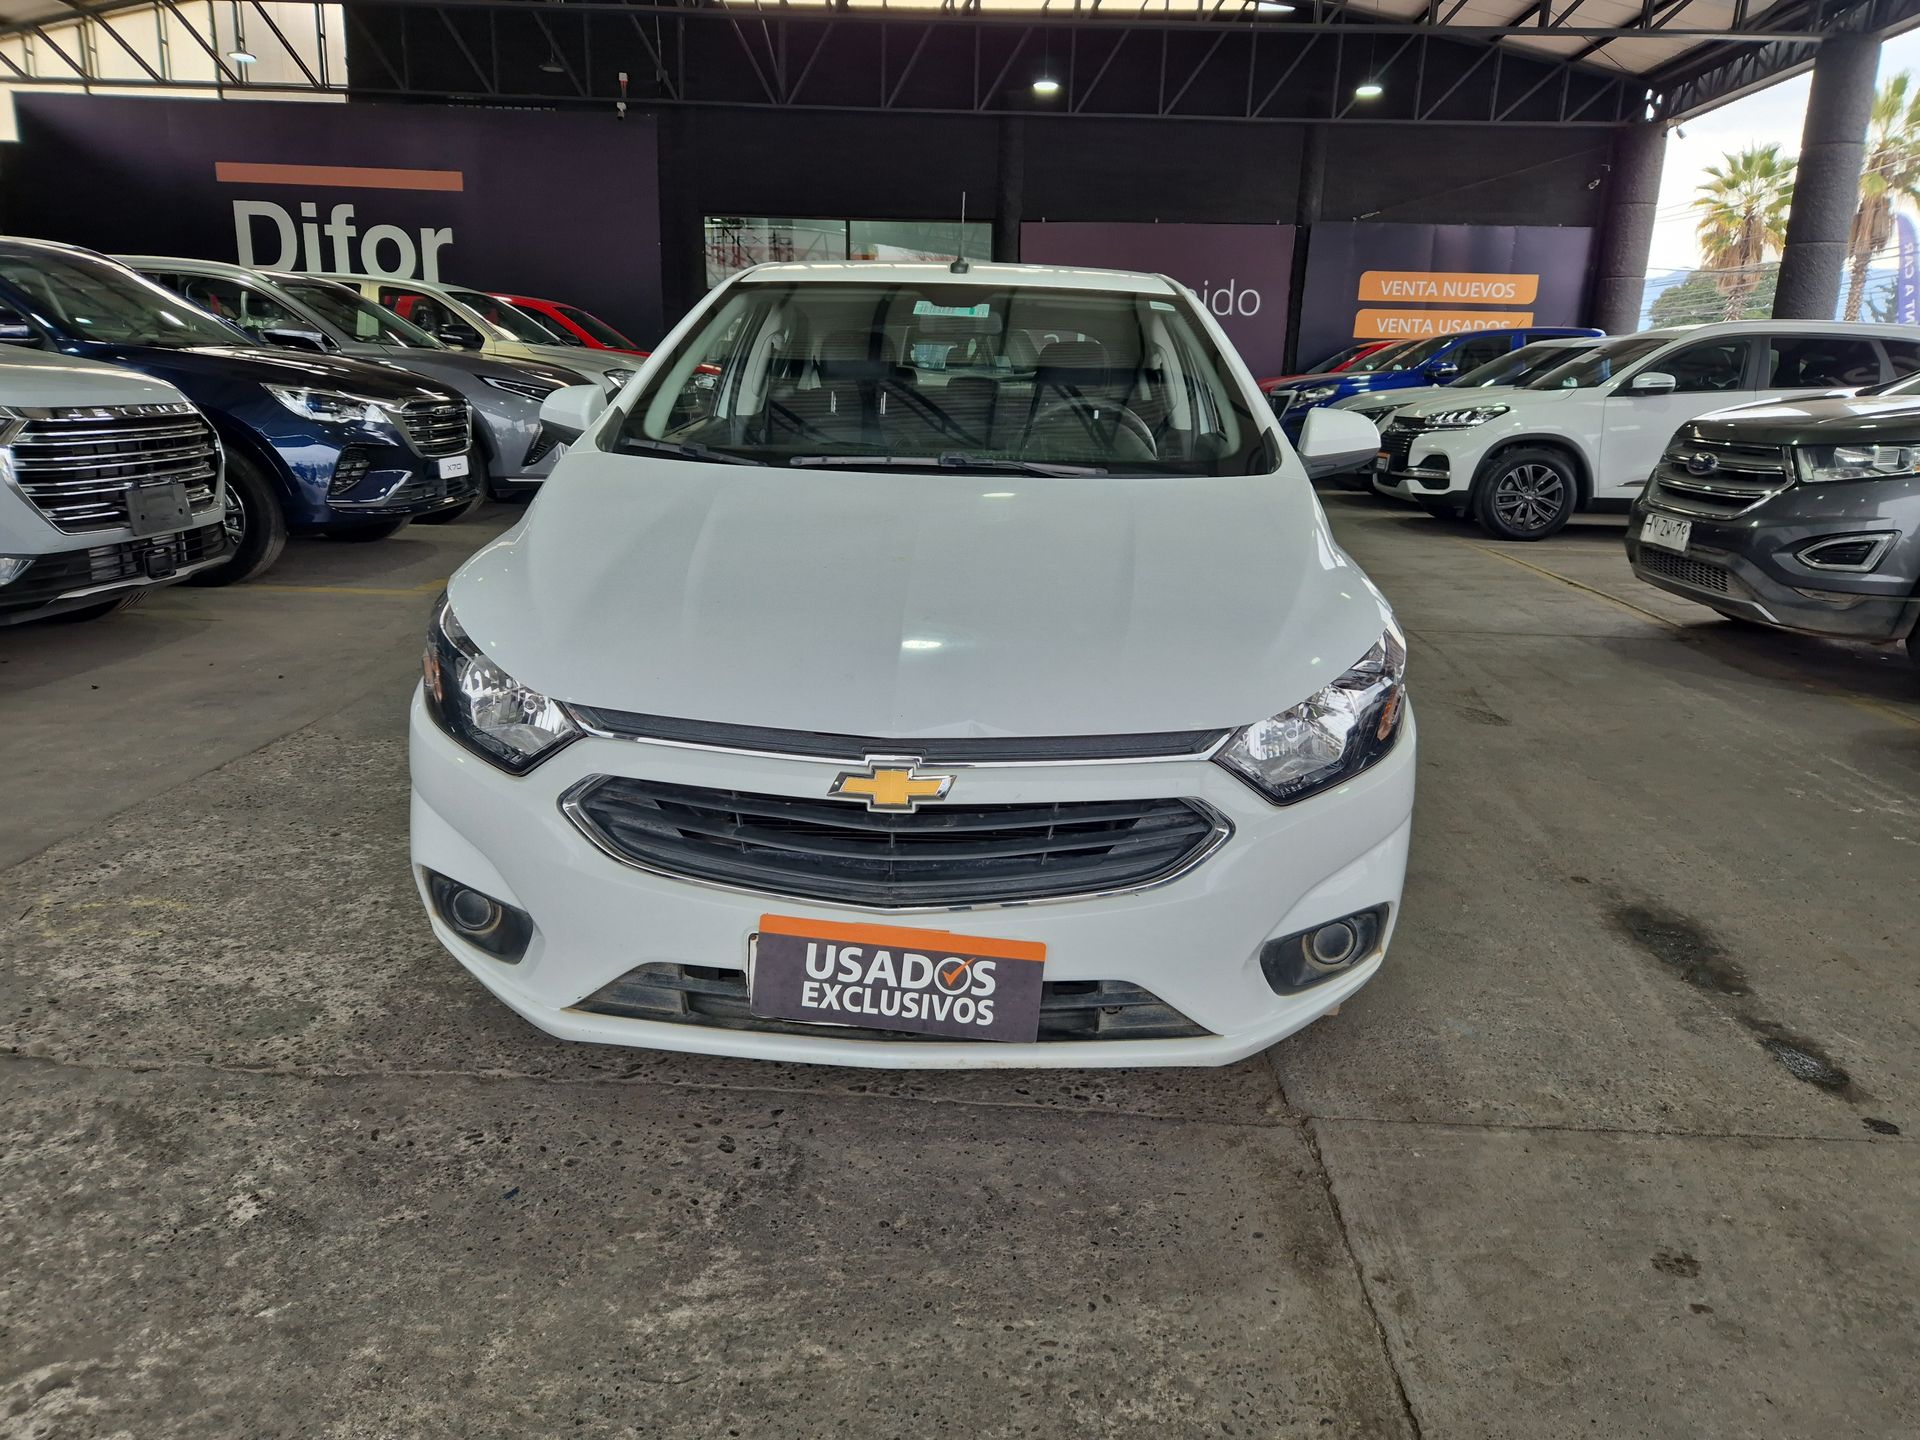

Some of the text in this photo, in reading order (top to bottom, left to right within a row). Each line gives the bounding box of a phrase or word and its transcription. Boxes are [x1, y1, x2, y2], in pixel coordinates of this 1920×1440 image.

[233, 200, 454, 283] Difor
[1381, 280, 1516, 298] VENTA NUEVOS
[1376, 318, 1434, 334] VENTA
[447, 463, 462, 471] X70
[805, 943, 997, 997] USADOS
[801, 981, 994, 1026] EXCLUSIVOS
